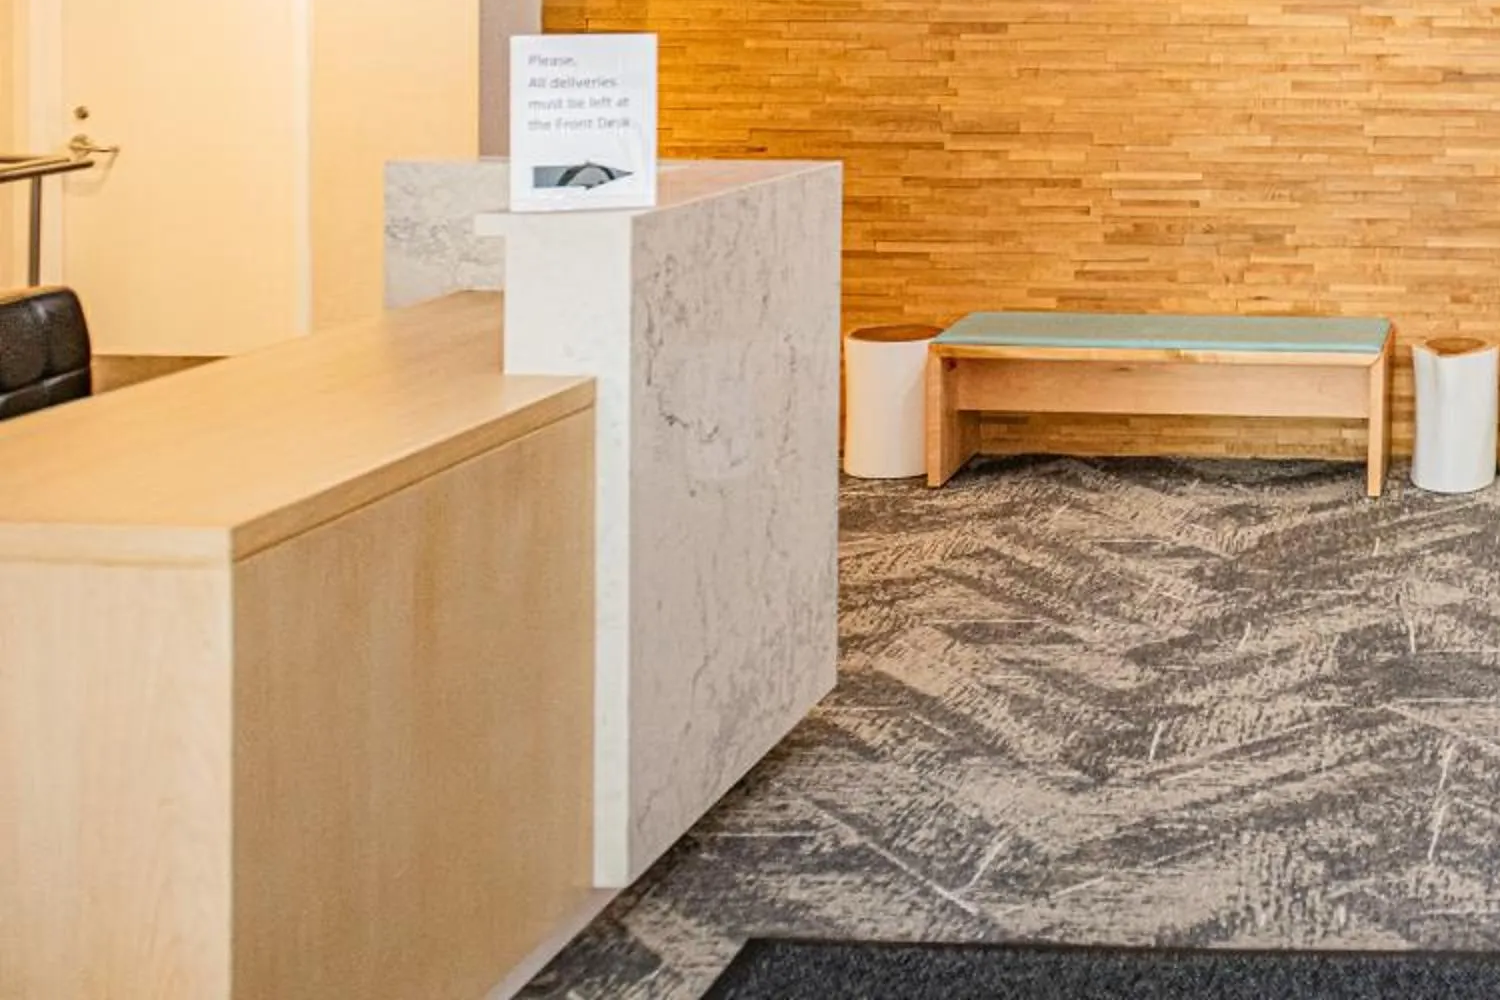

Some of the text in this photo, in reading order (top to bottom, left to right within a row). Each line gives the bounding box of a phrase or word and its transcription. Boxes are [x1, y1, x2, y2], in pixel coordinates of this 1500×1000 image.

[528, 75, 618, 89] All deliveries
[528, 95, 630, 110] must be left at
[527, 119, 551, 131] the
[555, 117, 593, 130] Front
